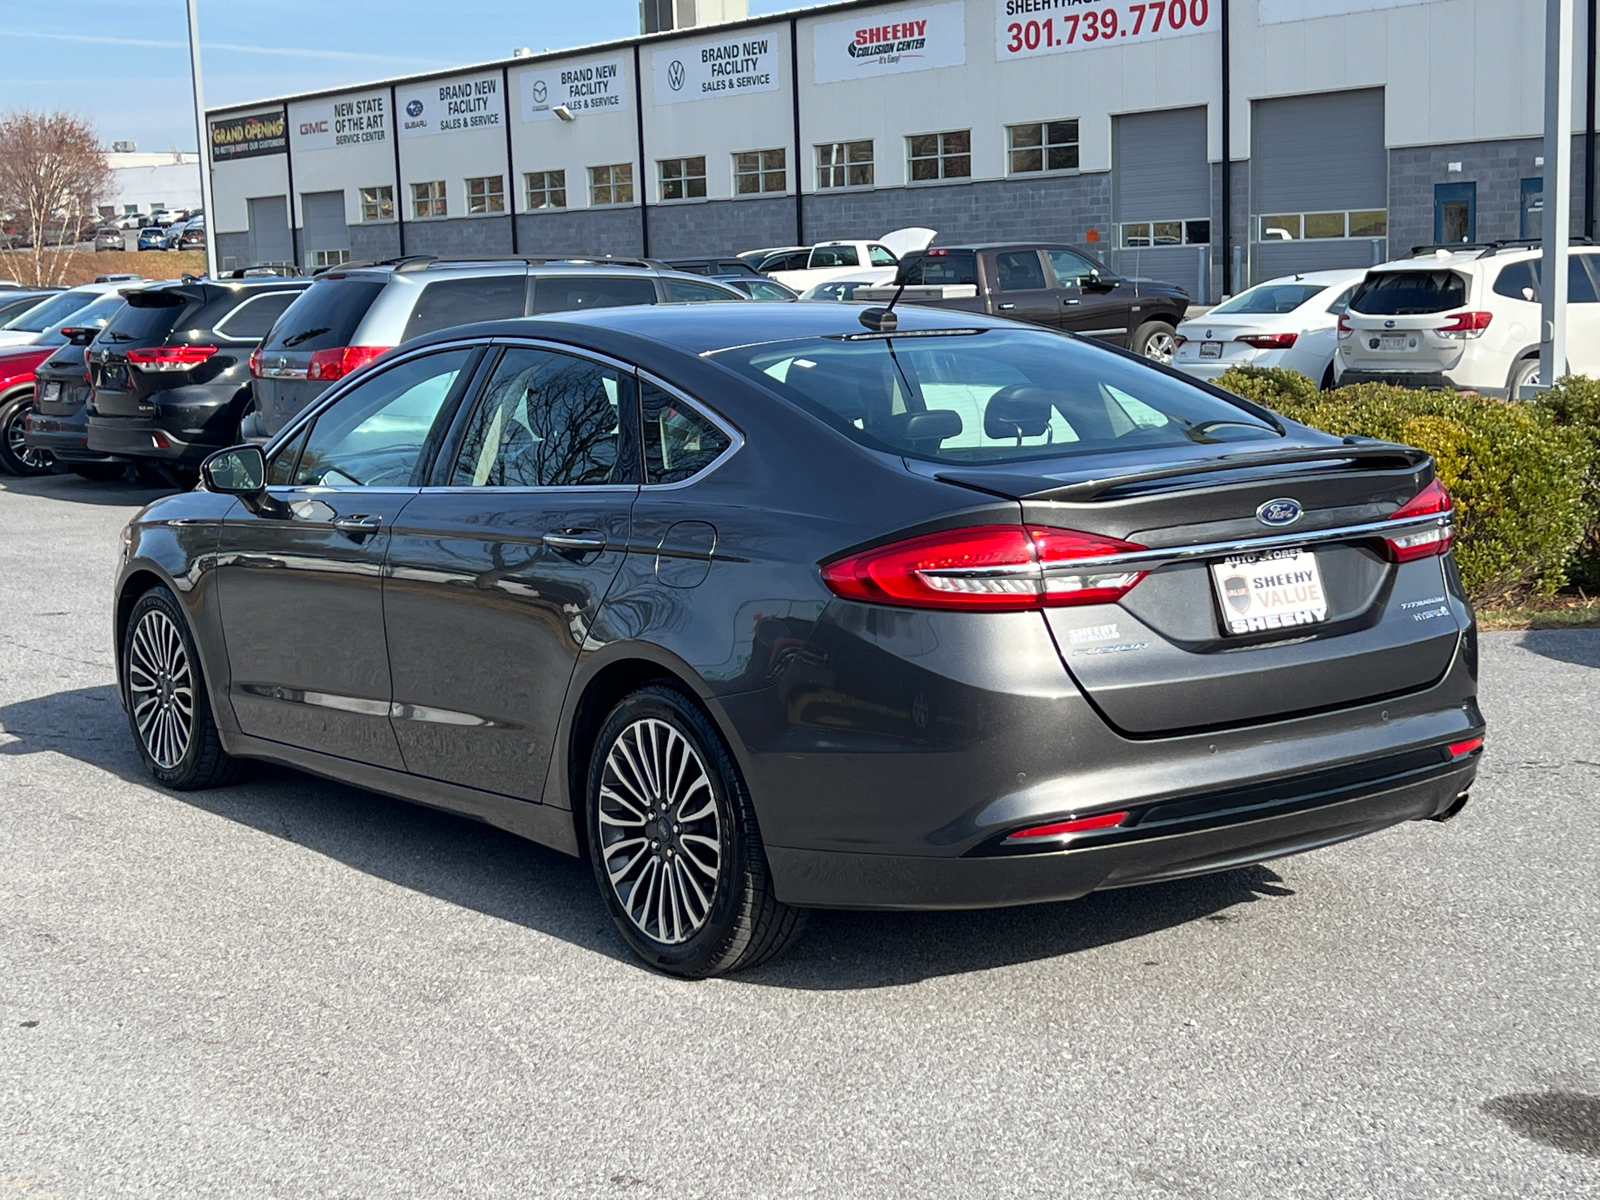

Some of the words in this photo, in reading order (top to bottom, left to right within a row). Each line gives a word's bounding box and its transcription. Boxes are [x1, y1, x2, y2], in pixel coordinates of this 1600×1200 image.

[855, 19, 927, 46] SHEEHY
[1007, 0, 1209, 53] 301.739.7700
[701, 44, 740, 63] BRAND
[742, 39, 768, 57] NEW
[856, 42, 895, 58] COLLISION
[896, 37, 926, 53] CENTER
[561, 68, 593, 85] BRAND
[595, 63, 617, 80] NEW
[711, 57, 758, 77] FACILITY
[439, 83, 472, 101] BRAND
[474, 78, 496, 95] NEW
[569, 80, 609, 98] FACILITY
[701, 79, 726, 92] SALES
[728, 78, 734, 89] &
[736, 73, 770, 88] SERVICE
[334, 102, 354, 118] NEW
[356, 97, 383, 115] STATE
[448, 96, 488, 116] FACILITY
[583, 99, 589, 109] &
[590, 95, 619, 108] SERVICE
[213, 125, 244, 144] GRAND
[244, 120, 283, 139] OPENING
[299, 120, 329, 136] GMC
[335, 119, 346, 134] OF
[347, 117, 364, 132] THE
[366, 114, 384, 130] ART
[404, 119, 428, 130] SUBARU
[440, 118, 462, 131] SALES
[463, 117, 468, 128] &
[470, 113, 499, 127] SERVICE
[335, 133, 361, 145] SERVICE
[361, 130, 385, 143] CENTER
[1267, 503, 1295, 520] Ford
[1223, 555, 1256, 566] AUTO
[1253, 570, 1313, 589] SHEEHY
[1256, 584, 1321, 608] VALUE
[1231, 607, 1327, 634] SHEEHY
[1067, 623, 1117, 640] SHEEHY
